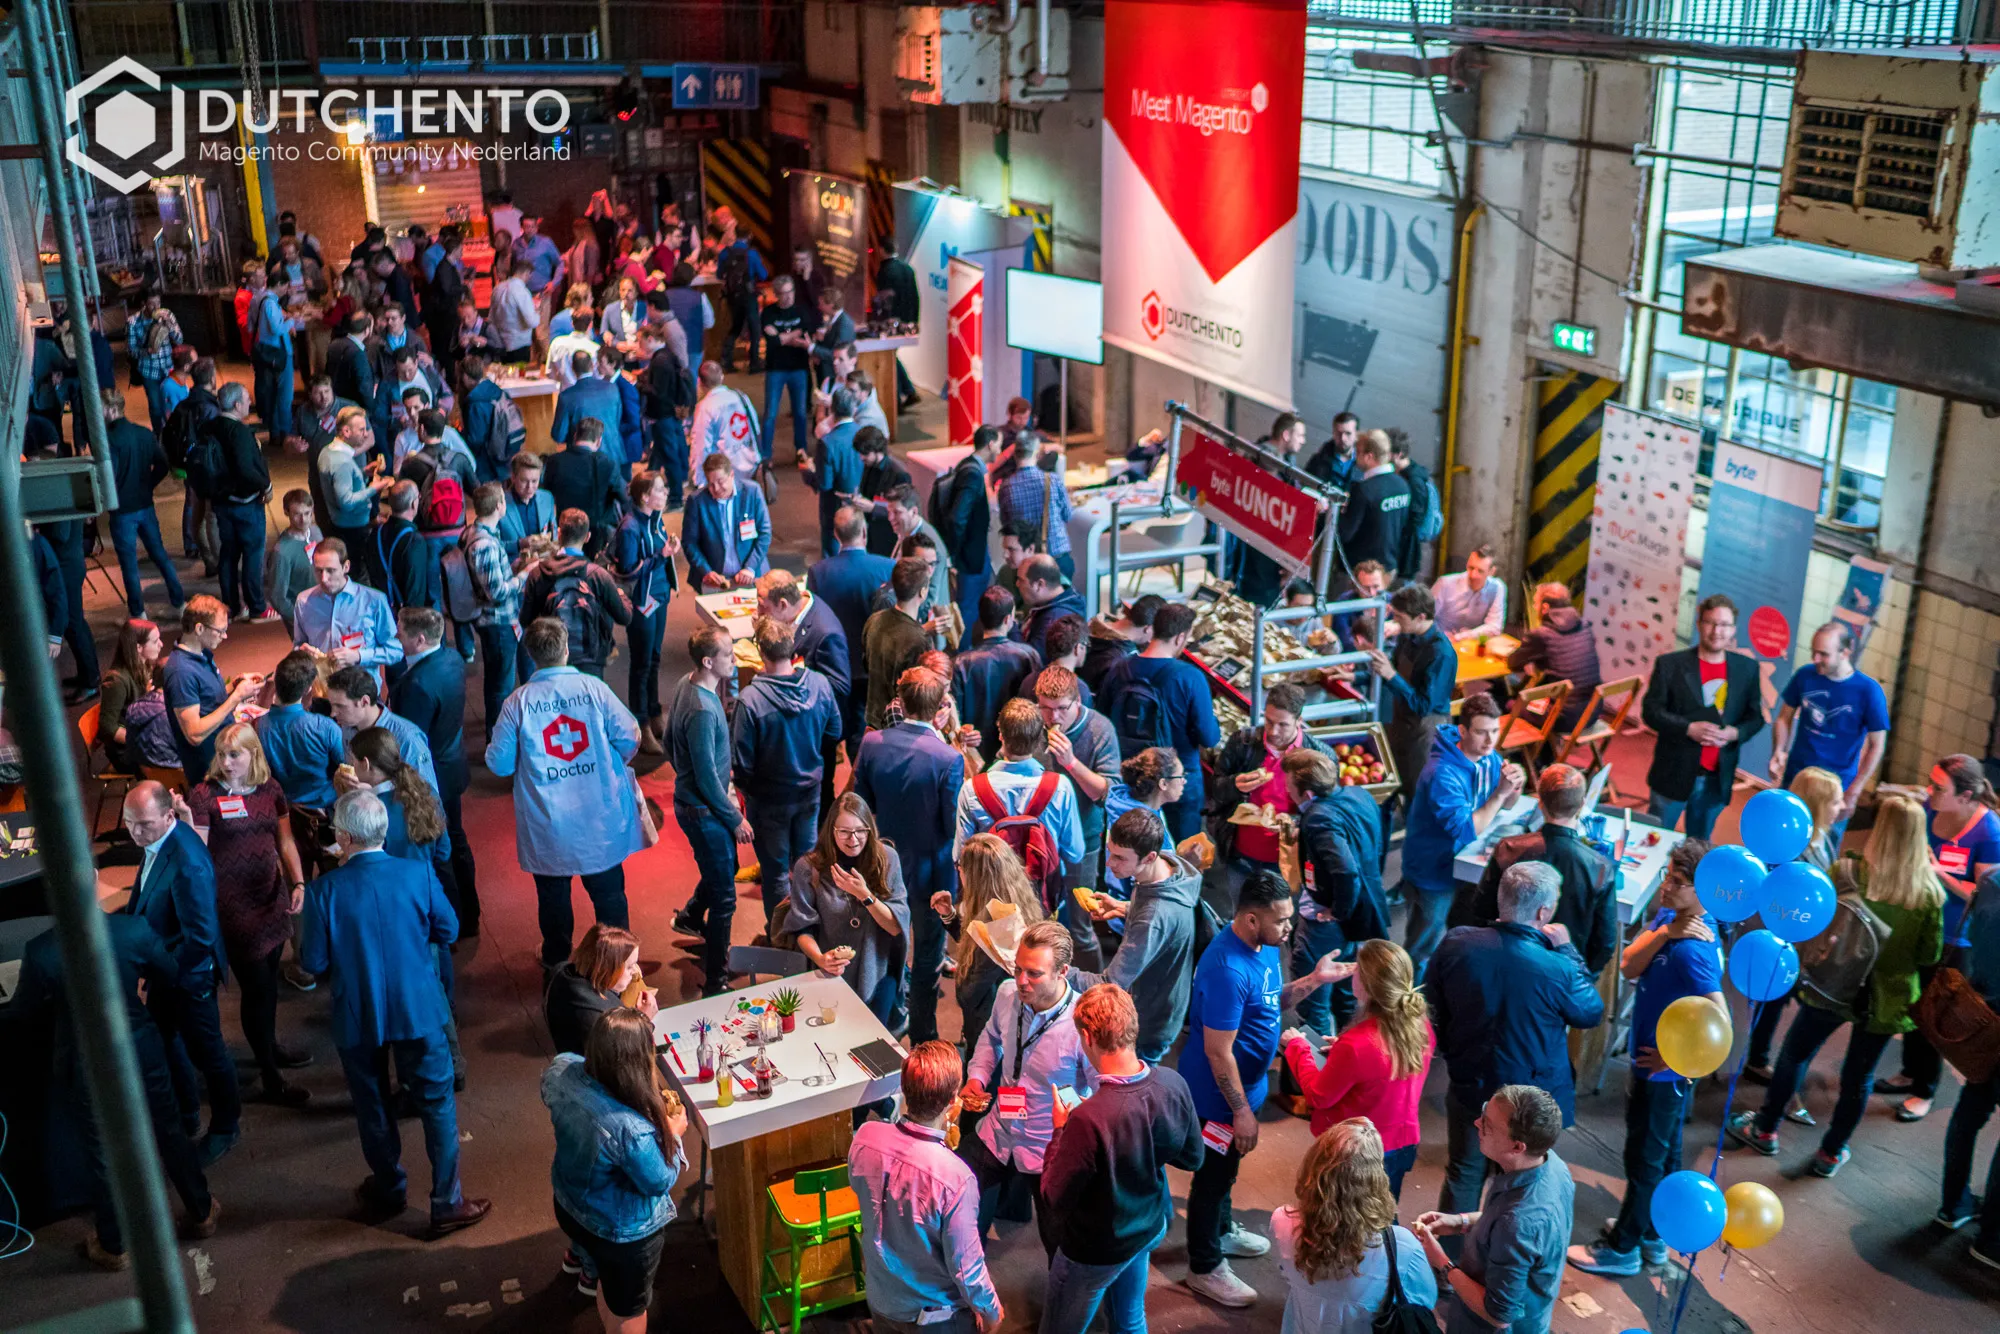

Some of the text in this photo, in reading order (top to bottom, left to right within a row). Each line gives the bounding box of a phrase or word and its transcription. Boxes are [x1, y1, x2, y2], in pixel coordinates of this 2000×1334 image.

[1131, 88, 1251, 136] Meet Magento
[1166, 307, 1243, 348] DUTCHENTO
[1672, 386, 1696, 404] DE
[1724, 456, 1758, 481] byte
[1210, 469, 1297, 537] byte LUNCH
[1380, 494, 1410, 512] CREW
[527, 694, 592, 715] Magento
[546, 762, 597, 781] Doctor
[1713, 884, 1748, 903] byt
[1768, 900, 1812, 923] byte
